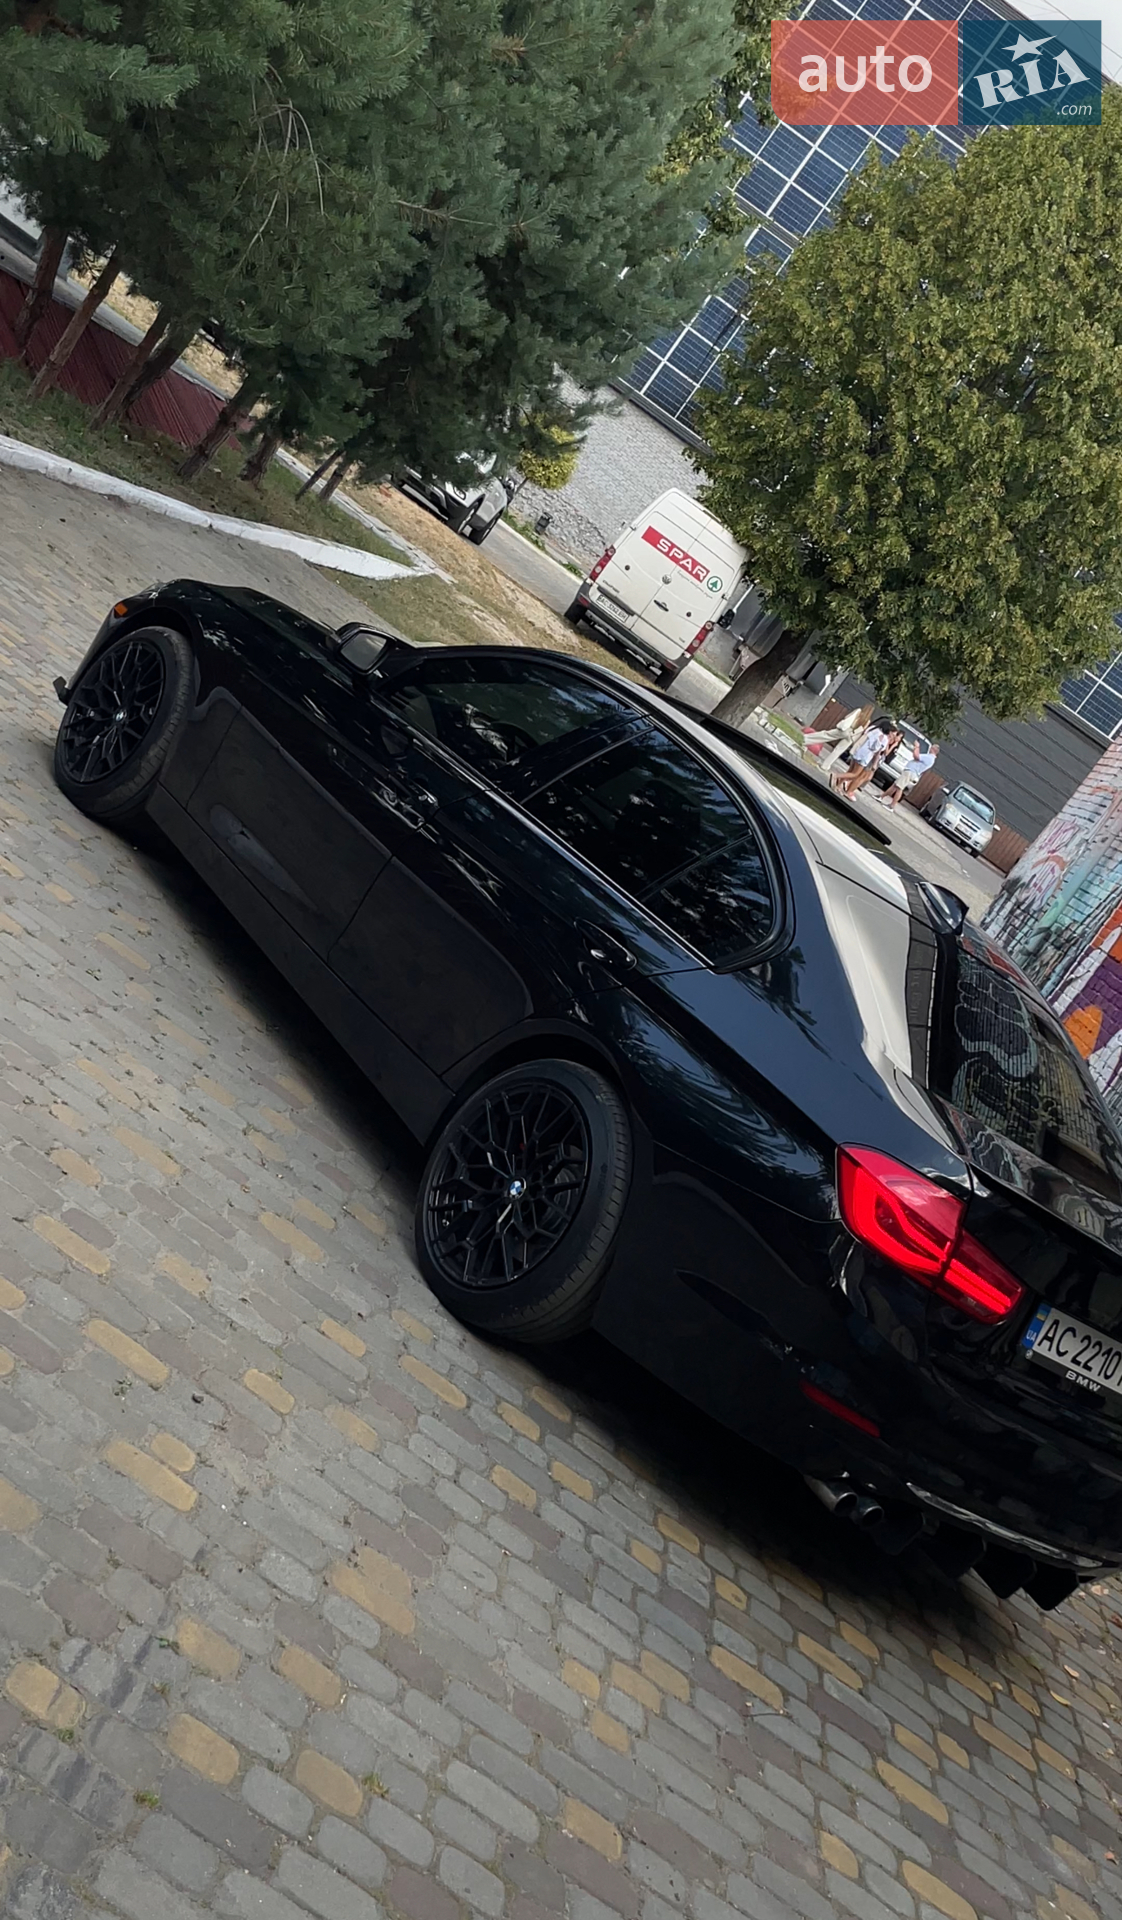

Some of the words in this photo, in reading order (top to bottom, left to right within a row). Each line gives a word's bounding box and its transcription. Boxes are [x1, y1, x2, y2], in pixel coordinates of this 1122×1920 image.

[656, 538, 708, 581] SPAR
[1026, 1330, 1037, 1341] UA
[1037, 1319, 1077, 1357] AC
[1070, 1334, 1122, 1380] 2210
[1065, 1370, 1101, 1392] BMW
